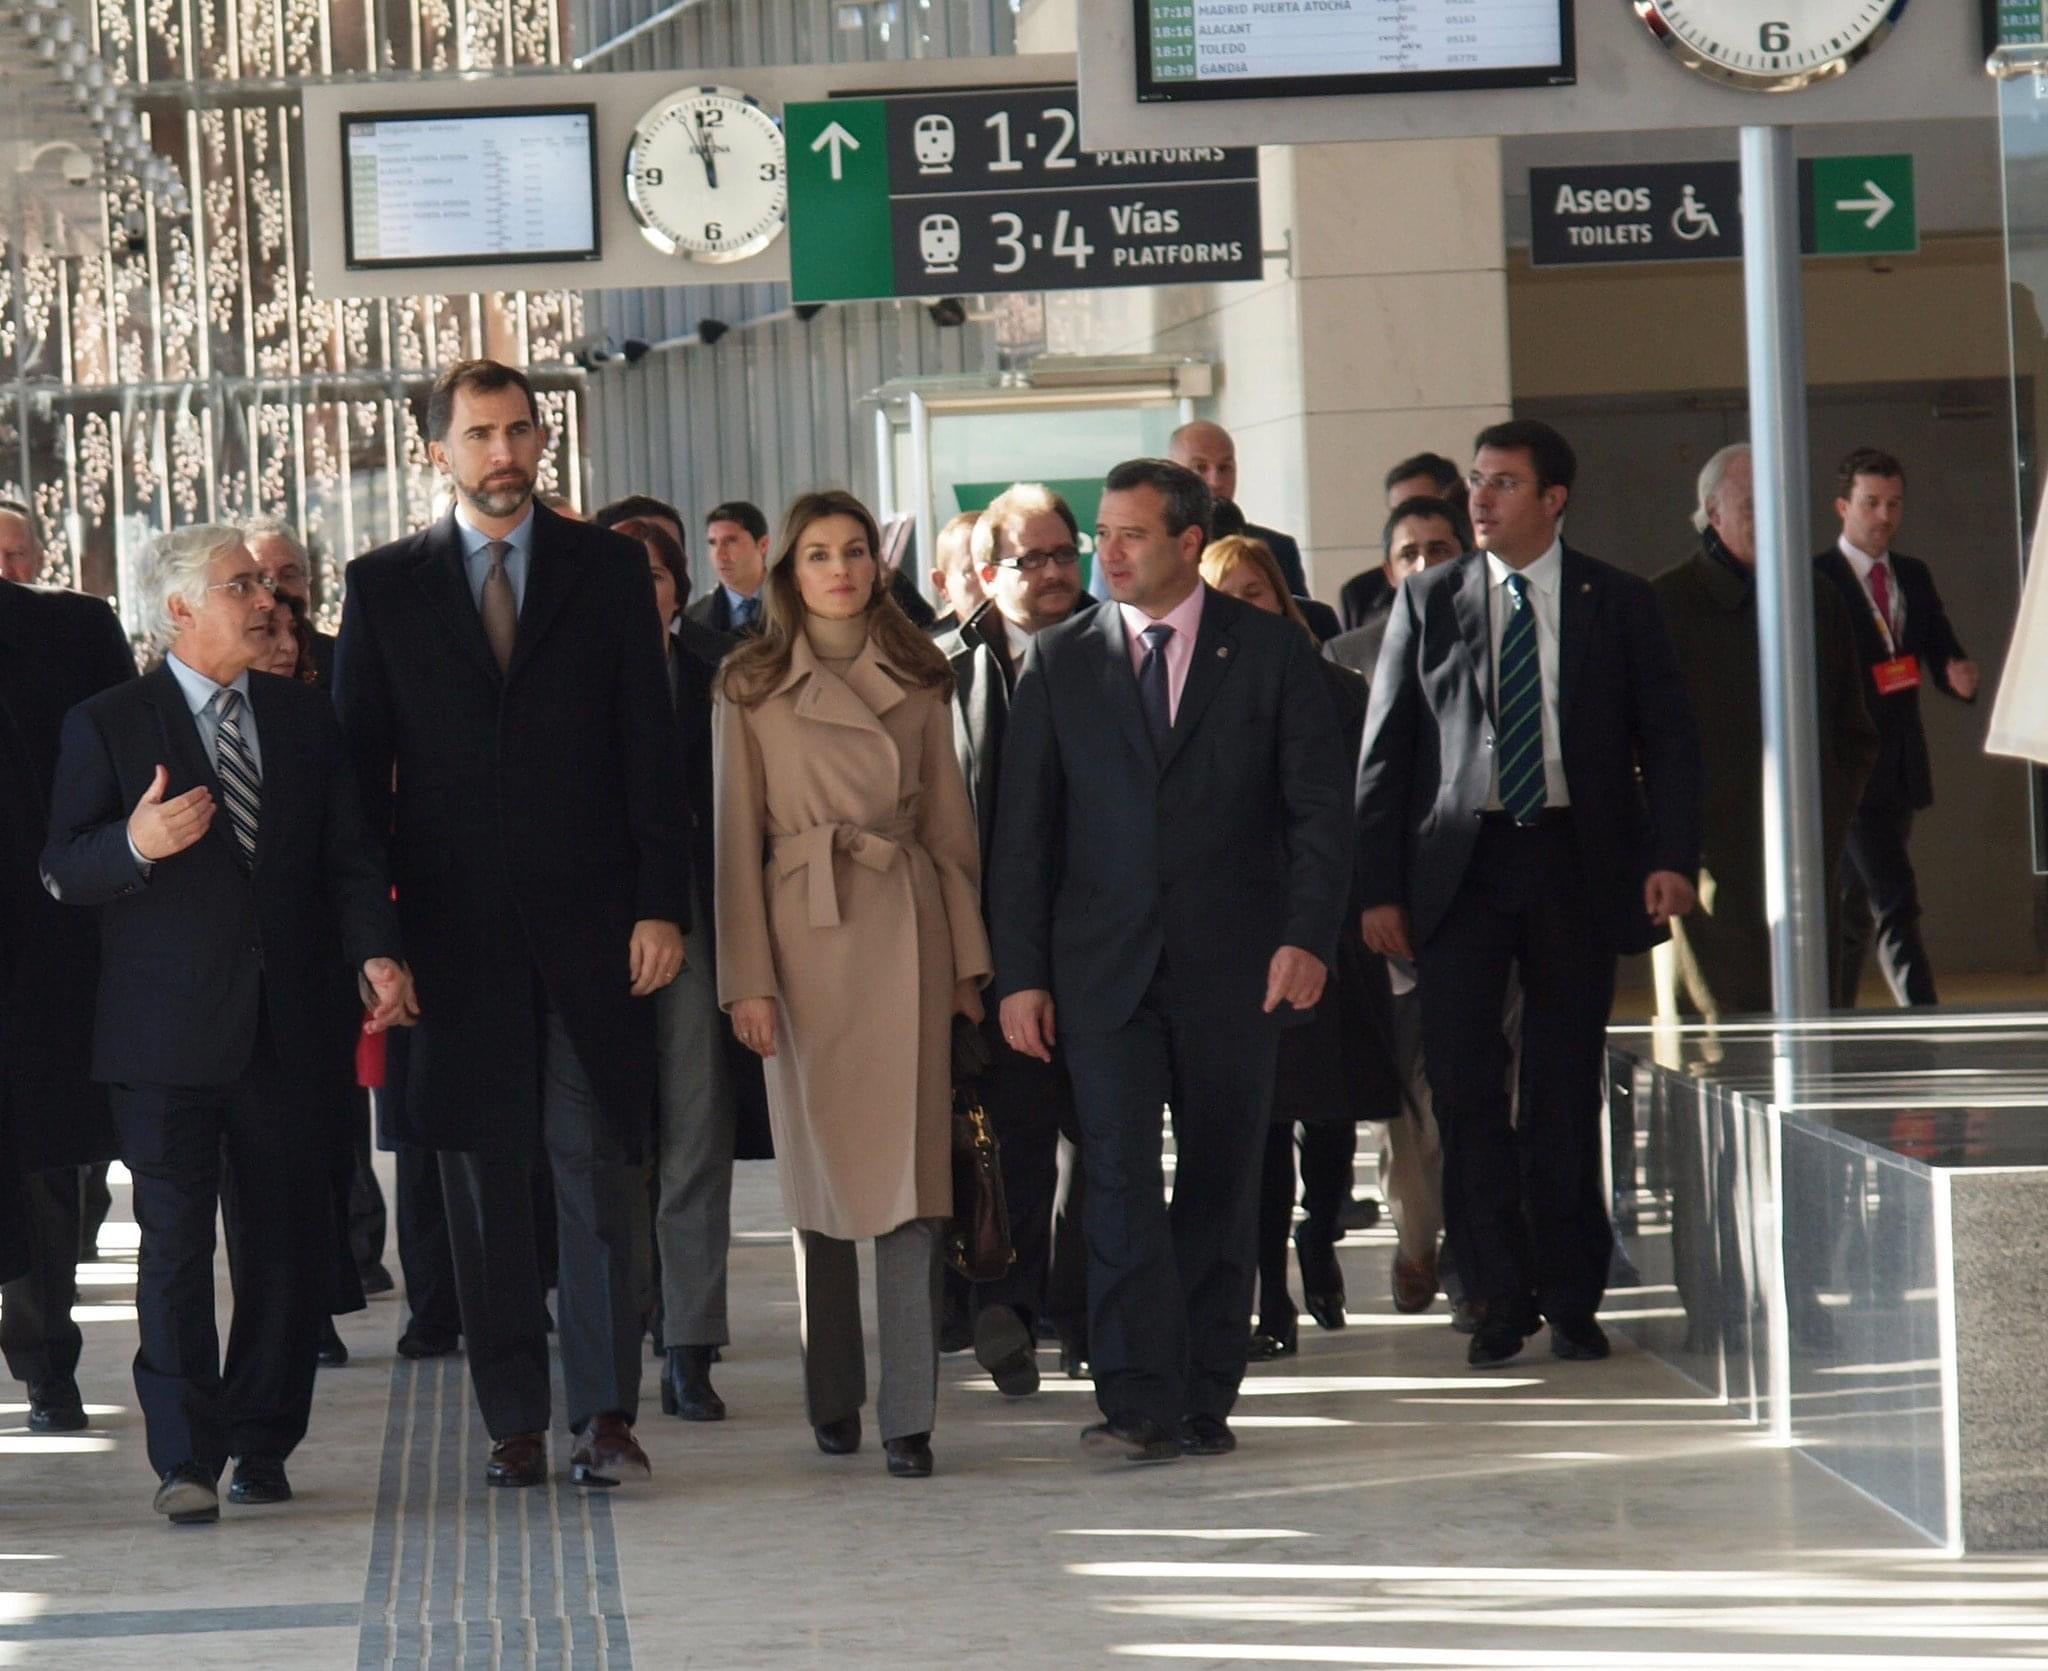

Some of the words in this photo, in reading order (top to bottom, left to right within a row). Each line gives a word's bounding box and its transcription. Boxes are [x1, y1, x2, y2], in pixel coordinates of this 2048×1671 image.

[1199, 4, 1248, 16] MADRID
[1253, 2, 1300, 14] PUERTA
[1304, 0, 1351, 11] ATOCHA
[1199, 23, 1252, 35] ALACANT
[1759, 21, 1791, 53] 6
[1200, 43, 1247, 55] TOLEDO
[695, 109, 724, 128] 12
[1096, 147, 1226, 166] PLATFORMS
[645, 167, 664, 186] 9
[759, 163, 777, 181] 3
[1555, 184, 1652, 215] Aseos
[1109, 201, 1180, 235] Vías
[704, 221, 722, 241] 6
[1567, 224, 1654, 246] TOILETS
[1112, 241, 1243, 267] PLATFORMS
